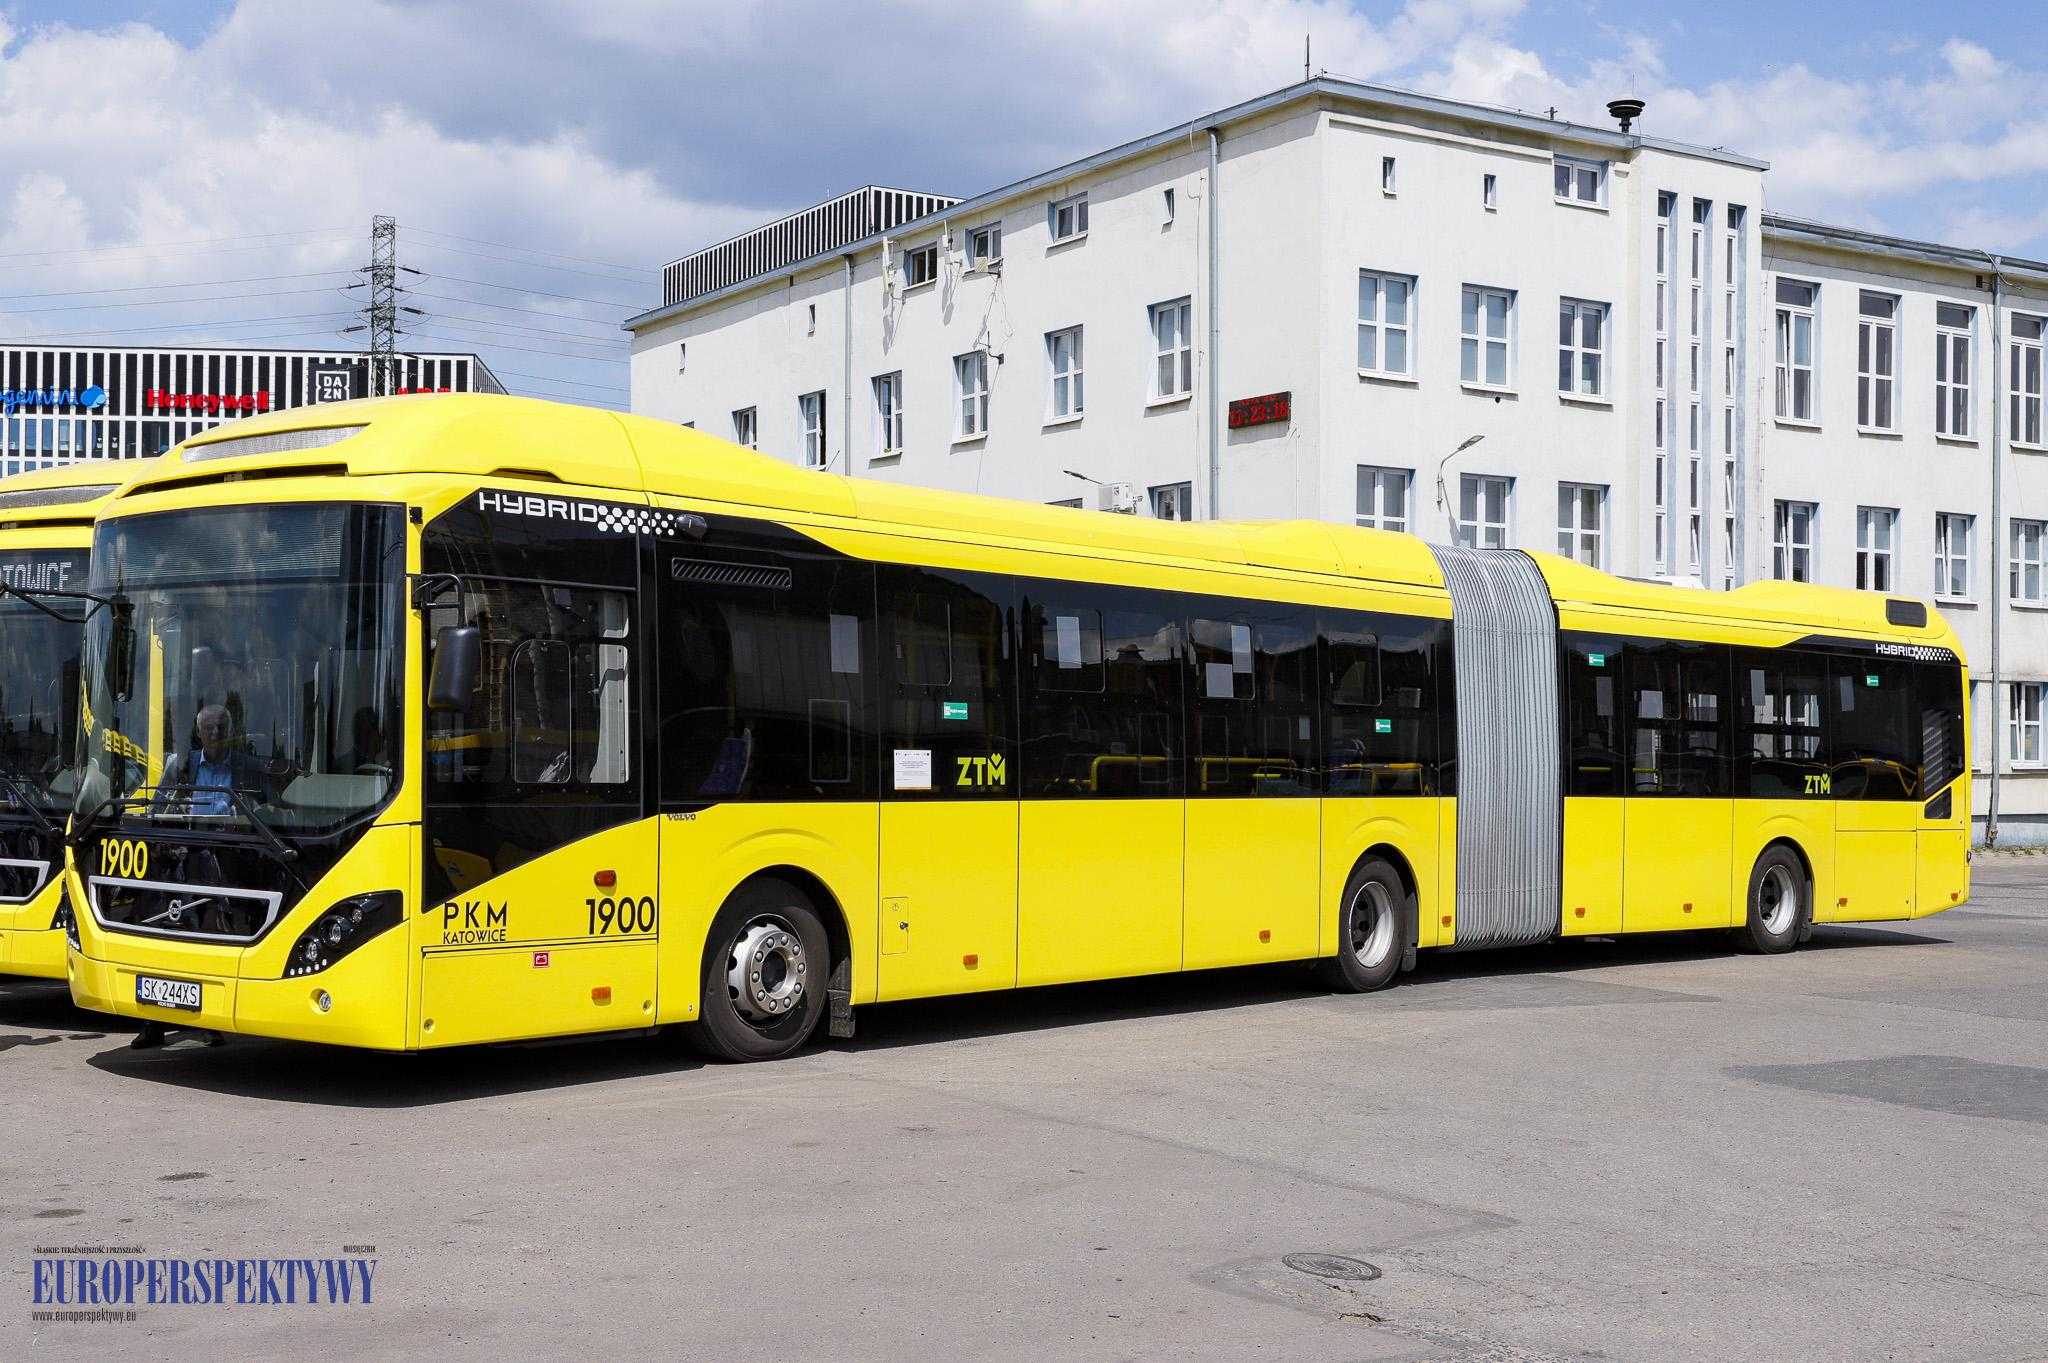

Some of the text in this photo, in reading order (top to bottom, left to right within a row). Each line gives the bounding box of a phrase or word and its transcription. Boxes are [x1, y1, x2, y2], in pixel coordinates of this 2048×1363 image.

[0, 385, 78, 418] gemini
[147, 388, 269, 413] Honeywell
[479, 491, 598, 523] HYBRID
[0, 562, 72, 598] TOWICE
[1875, 643, 1916, 657] HYBRID
[956, 753, 1006, 785] ZTM
[1804, 773, 1830, 794] ZTM
[100, 838, 148, 879] 1900
[443, 901, 507, 929] PKM
[586, 896, 655, 935] 1900
[443, 928, 506, 944] KATOWICE
